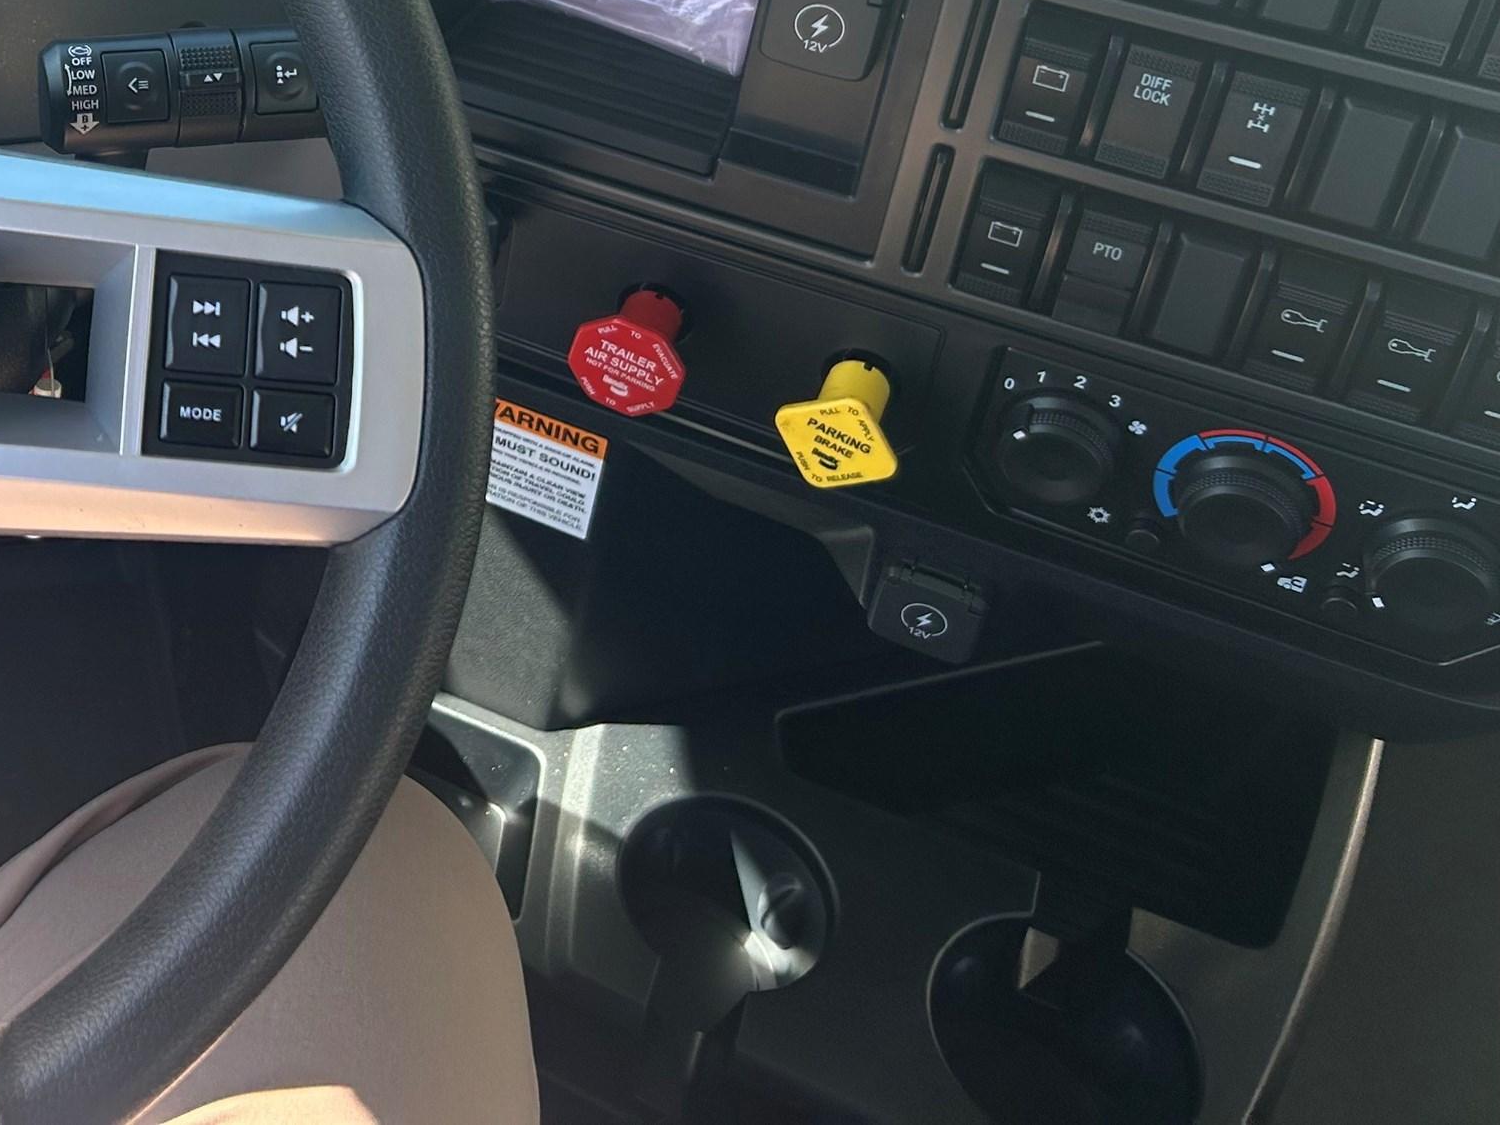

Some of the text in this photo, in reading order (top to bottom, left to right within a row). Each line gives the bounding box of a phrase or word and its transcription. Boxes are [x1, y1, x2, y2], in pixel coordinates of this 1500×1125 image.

[802, 39, 829, 54] 12V
[71, 56, 92, 67] OFF
[71, 68, 95, 81] LOW
[1140, 73, 1172, 92] DIFF
[72, 84, 97, 96] MED
[1133, 85, 1171, 107] LOCK
[71, 98, 99, 110] HIGH
[1092, 241, 1123, 262] PTO
[630, 330, 642, 339] TO
[600, 339, 657, 372] TRAILER
[584, 346, 664, 386] AIR SUPPLY
[586, 356, 656, 392] NOT FOR PARKING
[1003, 376, 1016, 392] 0
[1037, 370, 1048, 385] 1
[1073, 374, 1088, 390] 2
[605, 396, 617, 406] TO
[1108, 394, 1123, 409] 3
[179, 406, 222, 422] MODE
[495, 403, 600, 455] ARNING
[820, 406, 875, 442] PULL TO APPLY
[807, 417, 871, 454] PARKING
[814, 435, 854, 459] BRAKE
[495, 436, 536, 458] MUST
[539, 451, 596, 482] SOUND!
[811, 473, 823, 483] TO
[826, 472, 863, 482] RELEASE
[908, 626, 932, 640] 12V
